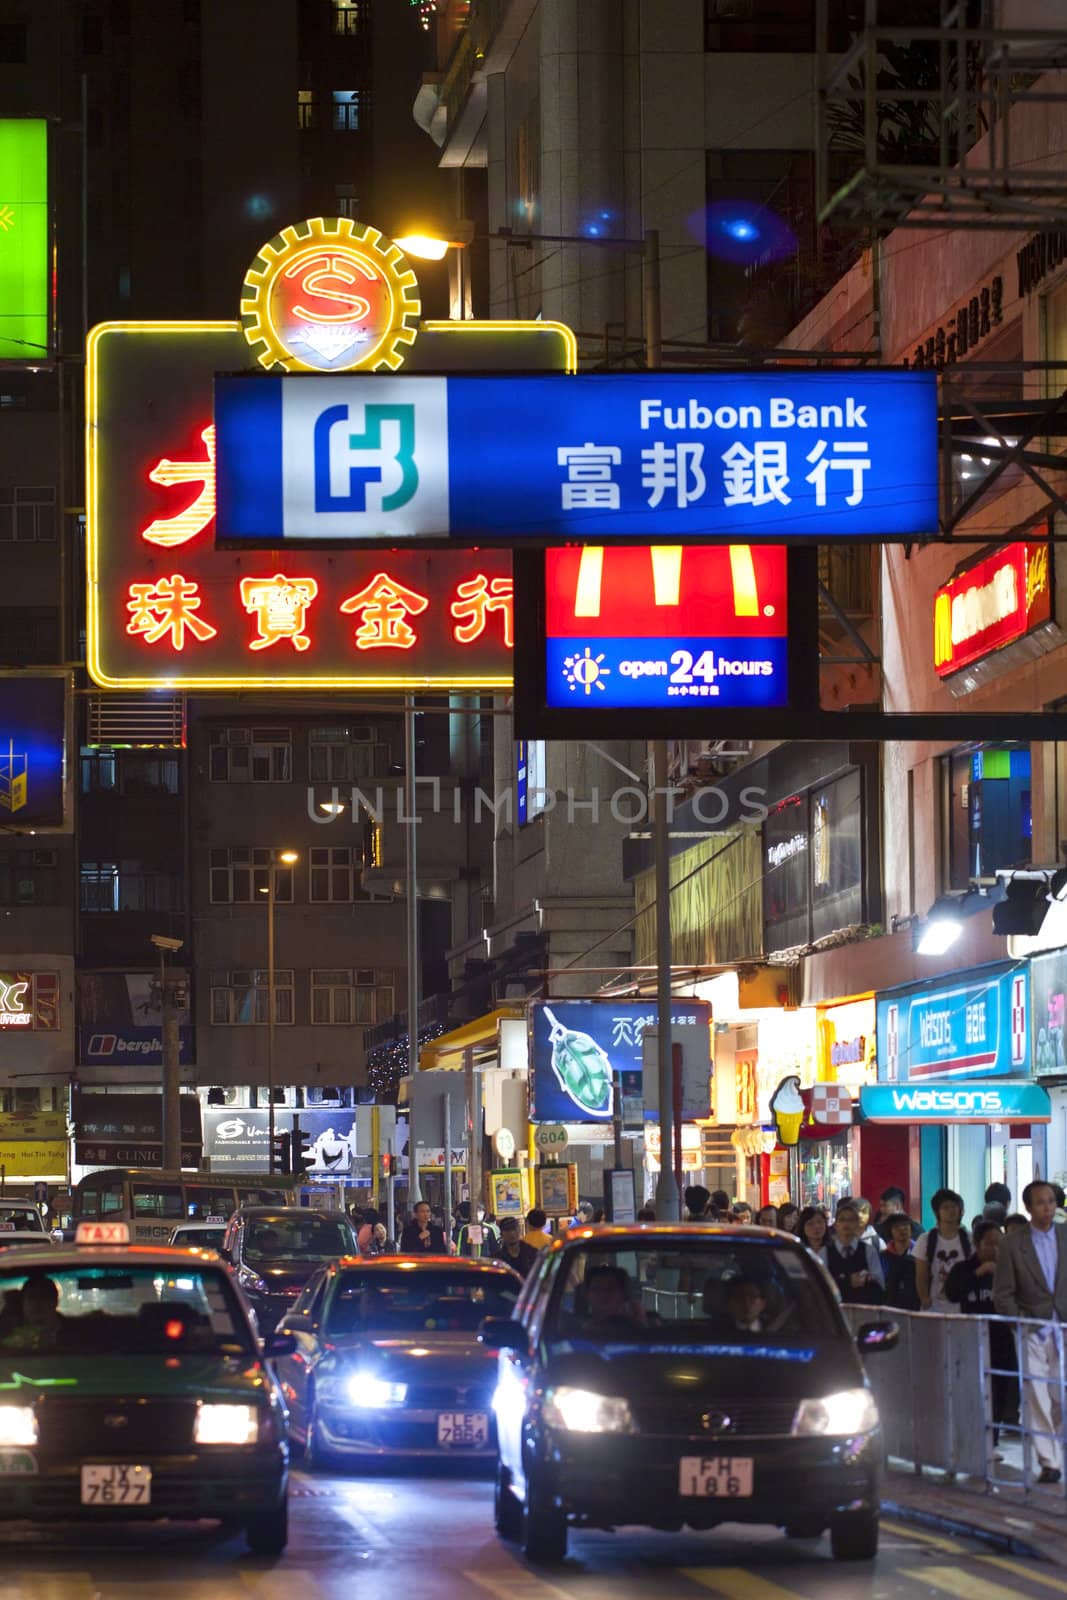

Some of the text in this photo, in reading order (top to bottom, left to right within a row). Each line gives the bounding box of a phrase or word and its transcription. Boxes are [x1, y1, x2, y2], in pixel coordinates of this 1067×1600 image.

[640, 397, 868, 430] Fubon Bank
[557, 439, 872, 511] 富邦銀行
[126, 572, 514, 651] 珠寶金行
[618, 649, 774, 684] open 24 hours
[116, 1037, 185, 1054] berghs
[892, 1089, 1002, 1111] Watsons
[539, 1130, 566, 1145] 604
[116, 1151, 160, 1161] CLINIC
[82, 1226, 126, 1239] TAXI
[452, 1413, 473, 1427] LE
[102, 1465, 131, 1486] JX
[701, 1456, 732, 1476] FH
[87, 1484, 147, 1504] 7677
[691, 1475, 741, 1496] 186
